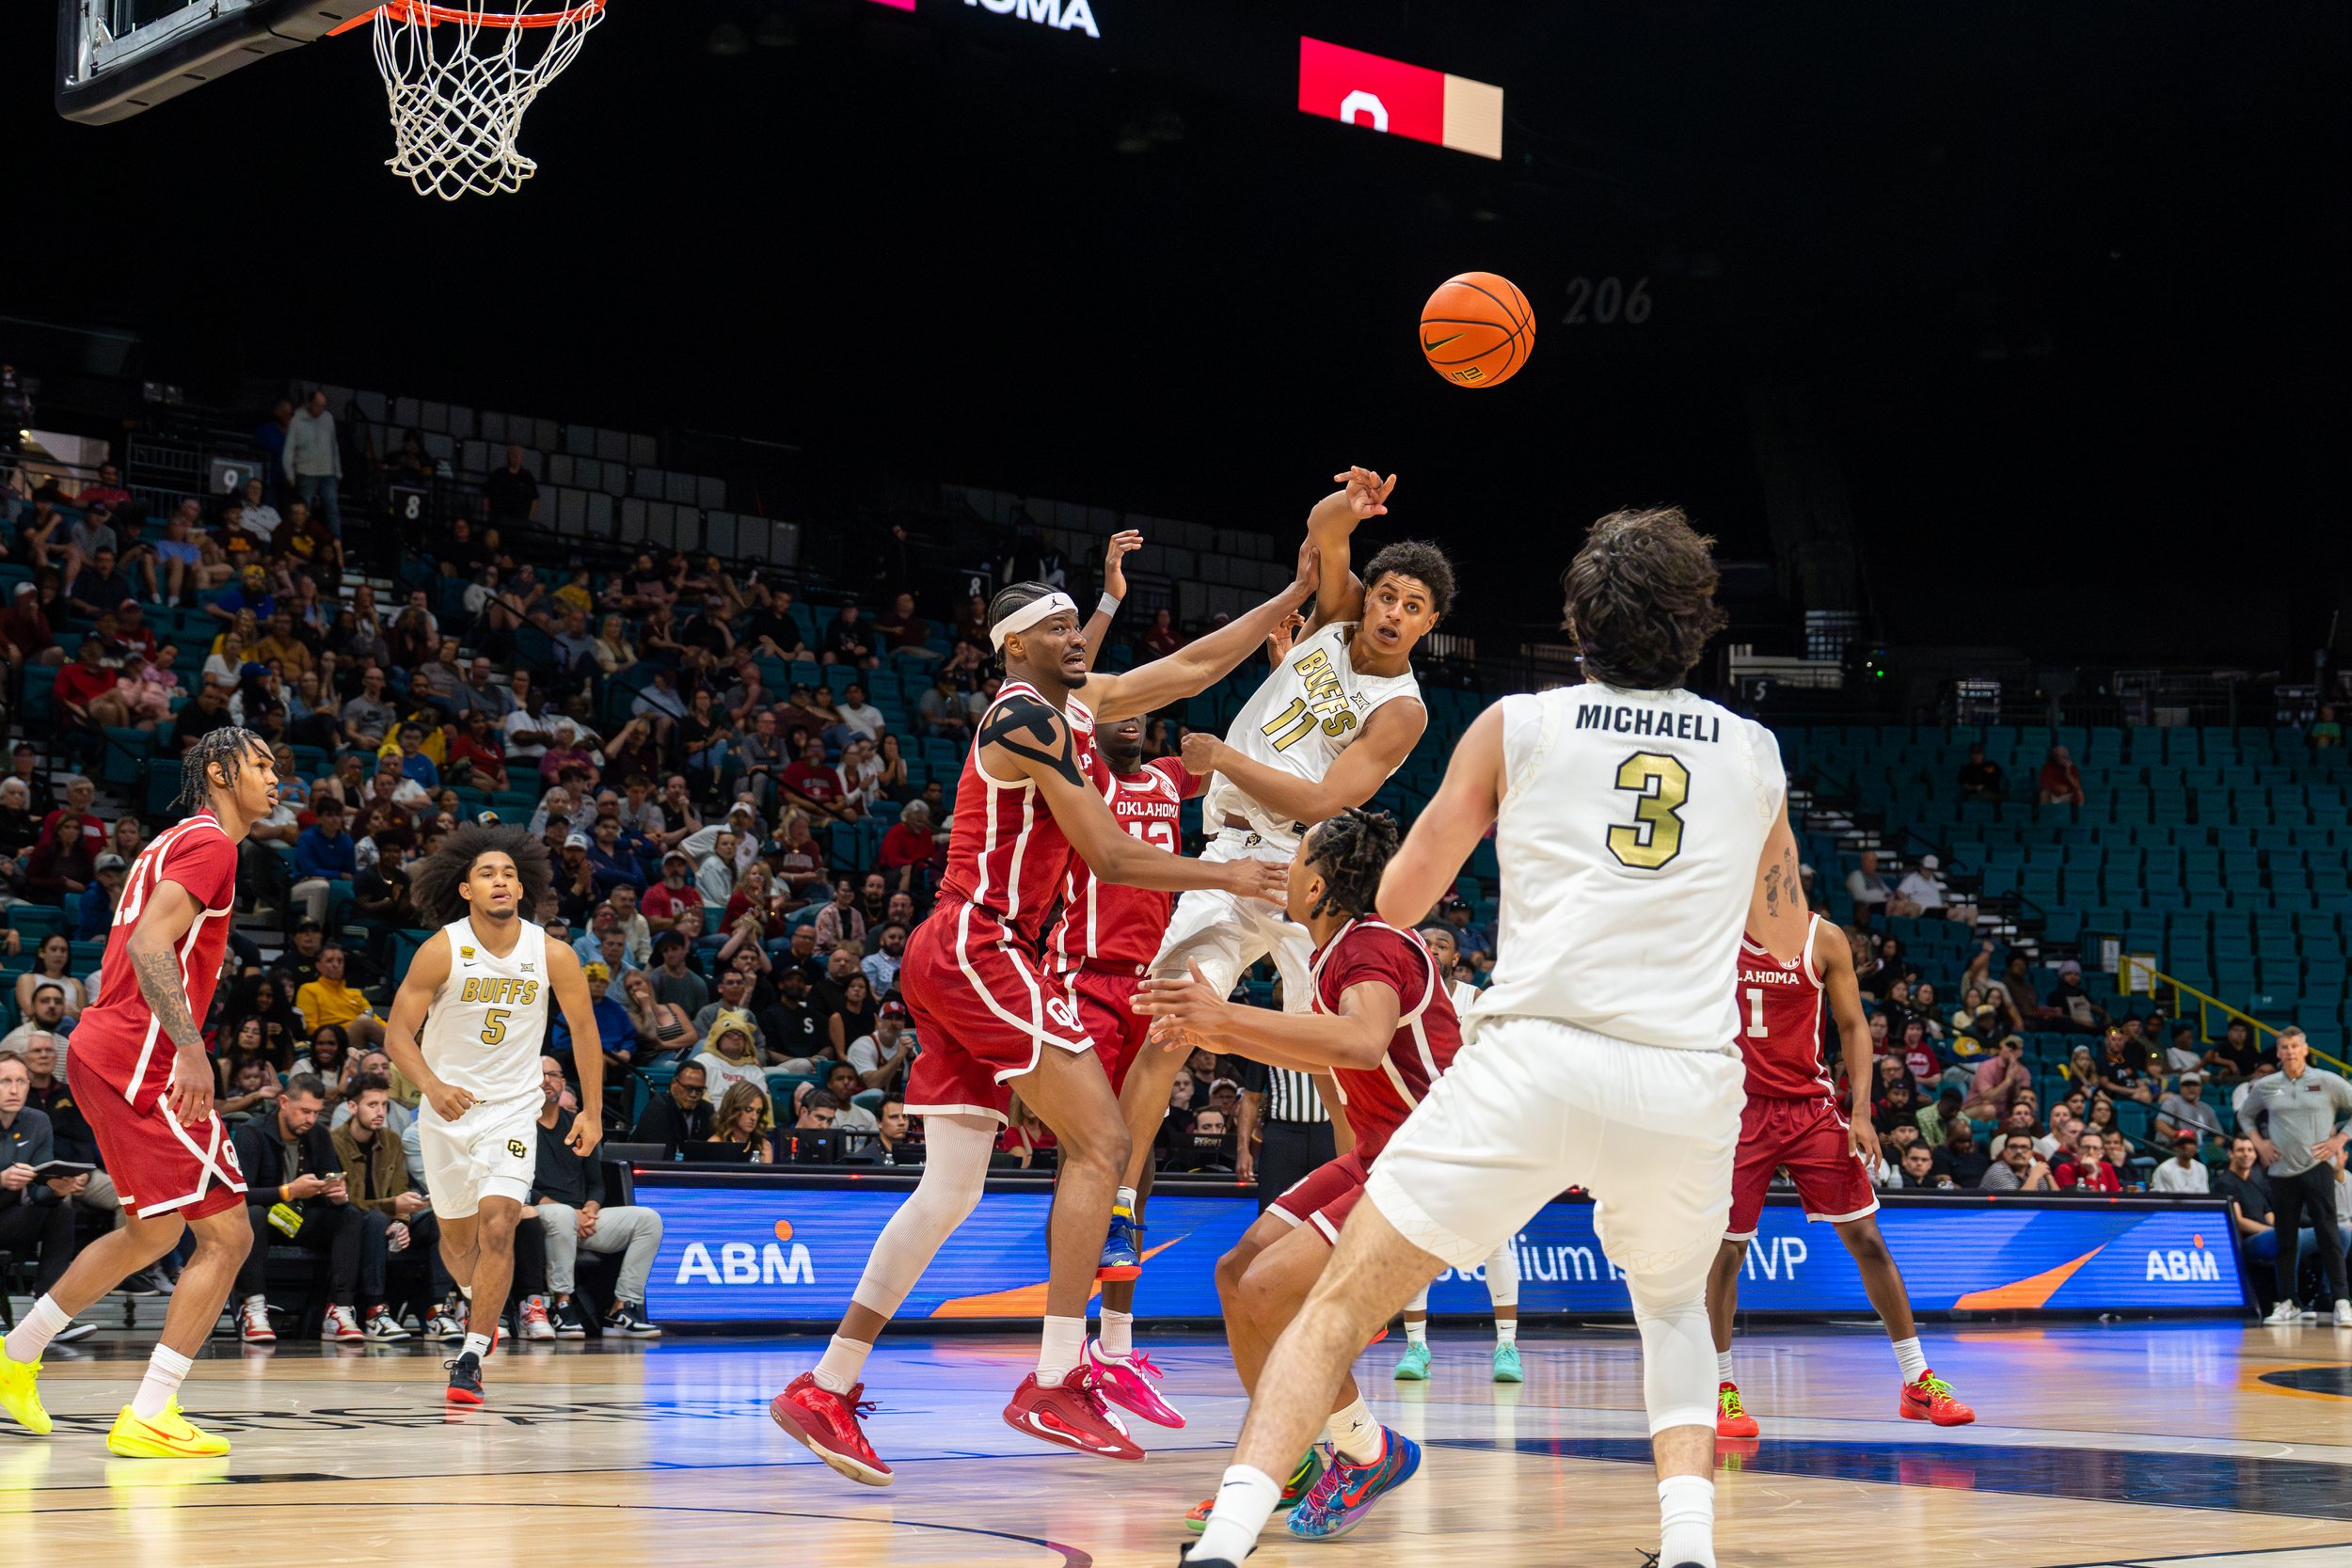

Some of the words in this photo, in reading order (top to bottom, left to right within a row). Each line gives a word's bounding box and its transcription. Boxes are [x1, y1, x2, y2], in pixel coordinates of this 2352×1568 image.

[963, 0, 1101, 39] MA
[1562, 275, 1653, 324] 206
[223, 470, 238, 495] 9
[405, 495, 421, 519] 8
[1293, 647, 1358, 737] BUFFS
[1754, 682, 1767, 701] 5
[1261, 697, 1319, 752] 11
[1576, 705, 1720, 743] MICHAELI
[1117, 801, 1178, 818] OKLAHOMA
[1606, 751, 1691, 871] 3
[460, 977, 539, 1006] BUFFS
[481, 1008, 511, 1046] 5
[803, 1017, 814, 1034] S
[1746, 988, 1768, 1038] 1
[675, 1242, 816, 1284] ABM
[2146, 1250, 2220, 1281] ABM
